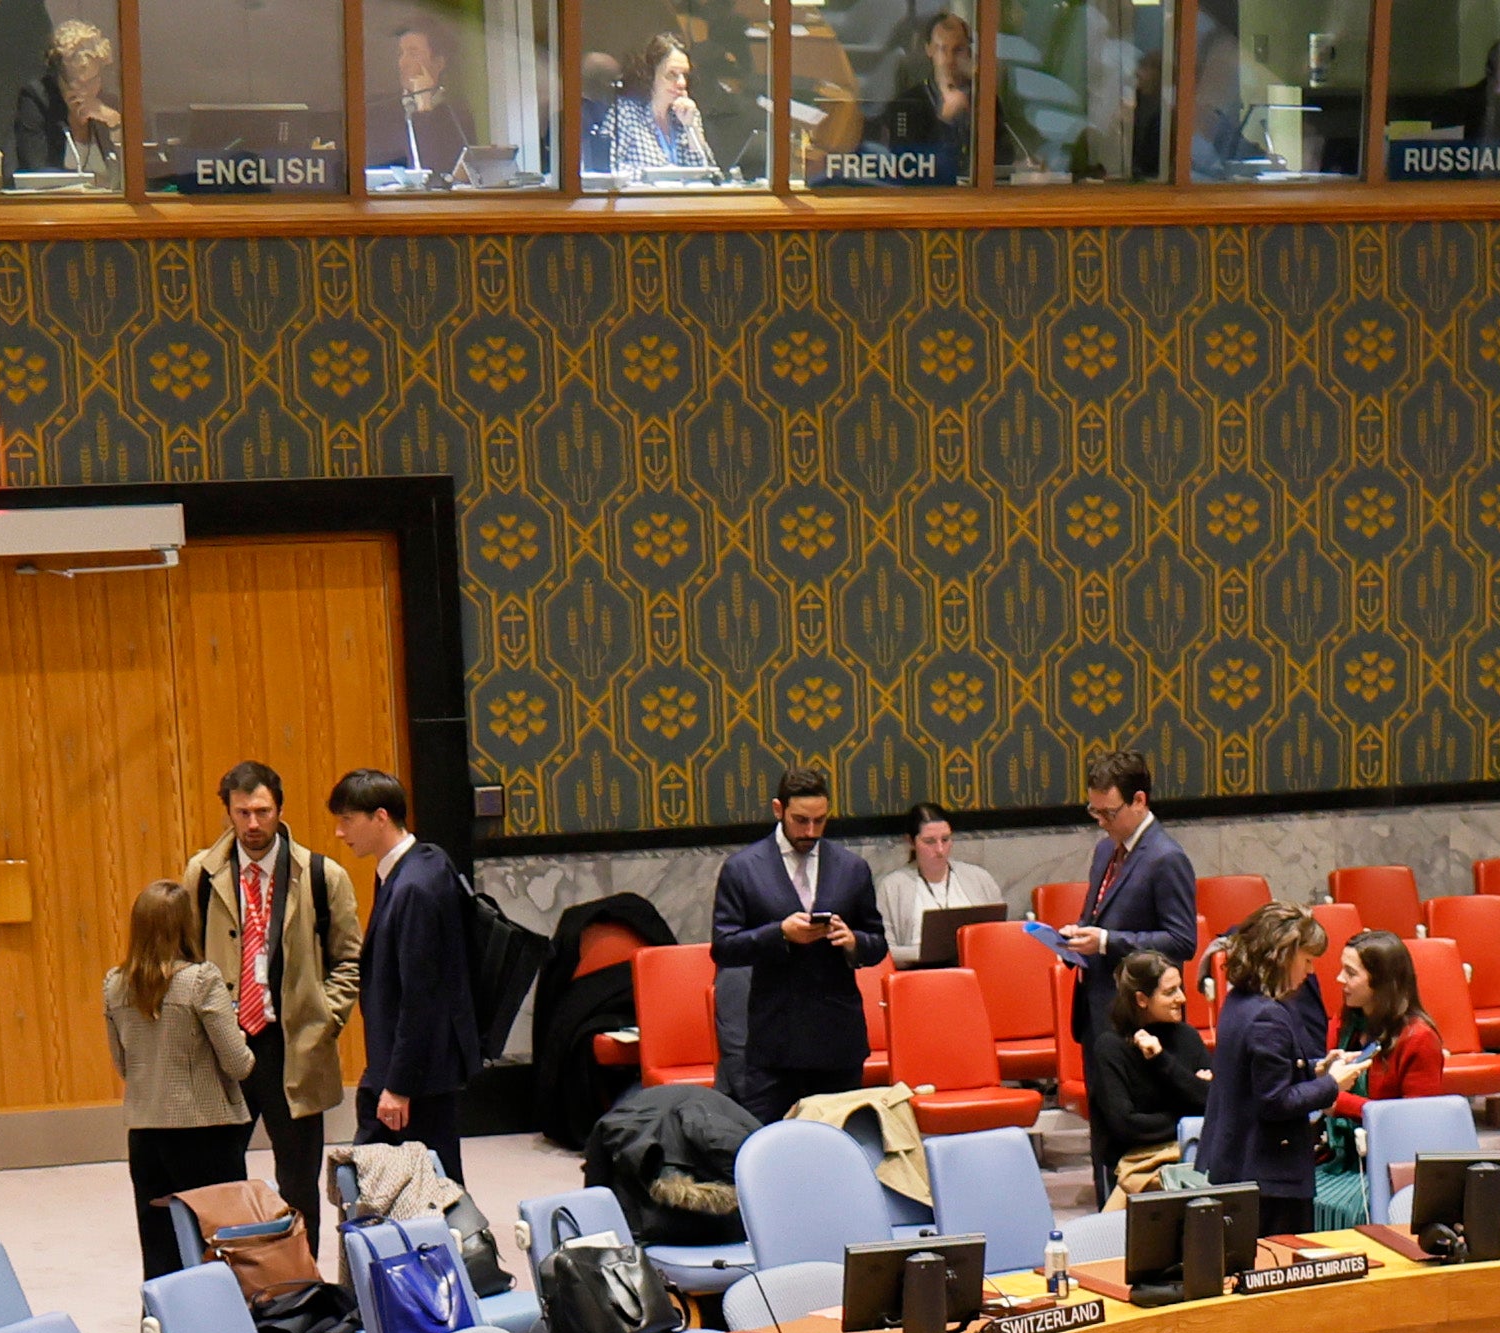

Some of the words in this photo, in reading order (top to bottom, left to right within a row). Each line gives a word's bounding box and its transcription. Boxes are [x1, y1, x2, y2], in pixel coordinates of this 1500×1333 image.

[196, 157, 326, 185] ENGLISH
[826, 152, 936, 179] FRENCH
[1245, 1271, 1285, 1290] UNITED
[1286, 1264, 1315, 1283] ARAB
[1315, 1256, 1366, 1278] EMIRATES
